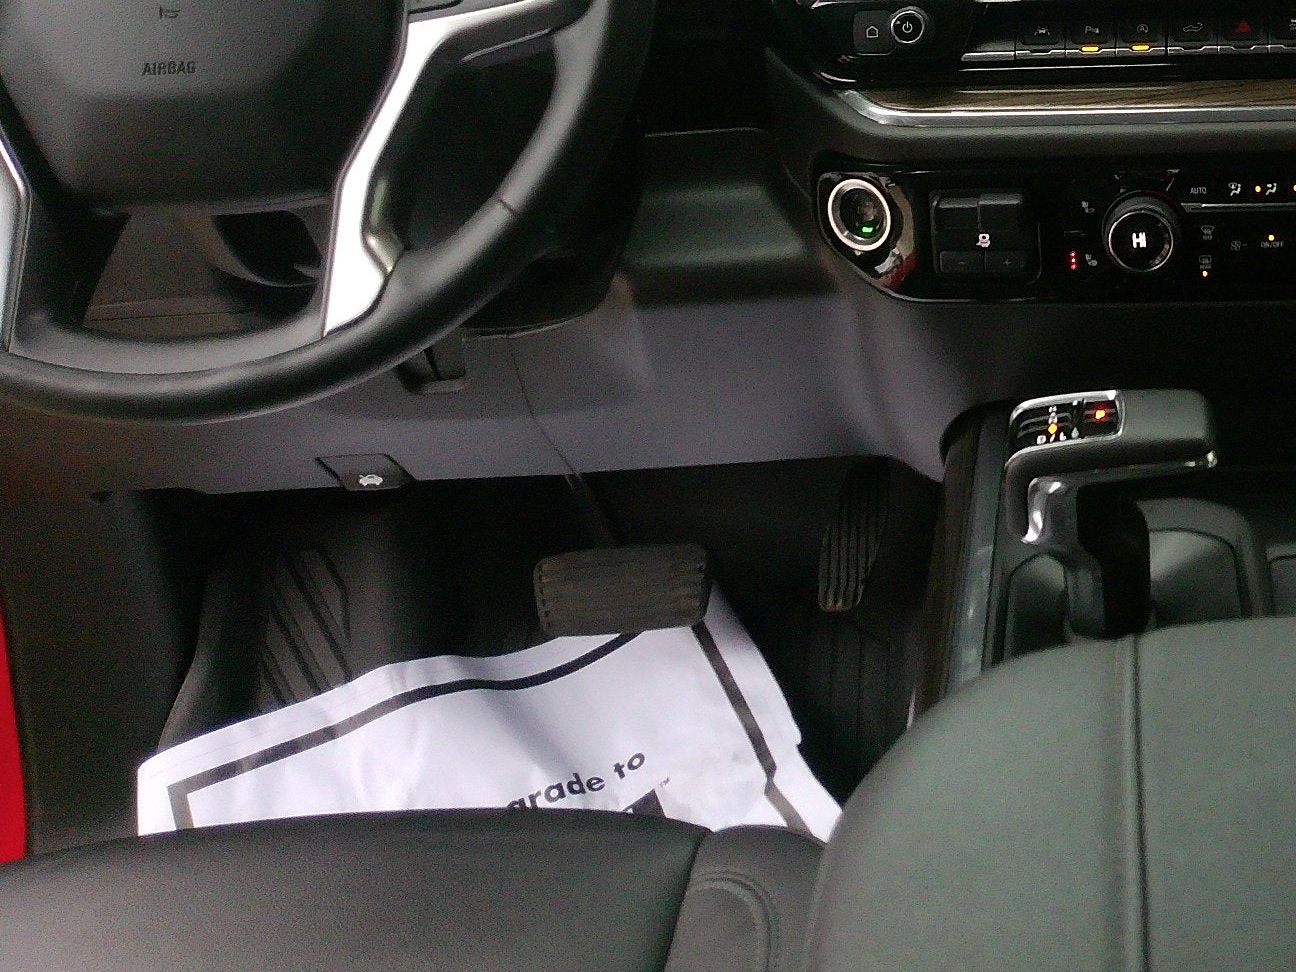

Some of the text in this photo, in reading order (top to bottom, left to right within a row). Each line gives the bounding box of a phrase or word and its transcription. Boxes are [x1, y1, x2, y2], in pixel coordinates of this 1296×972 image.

[141, 60, 197, 77] AIRBAG
[1189, 186, 1207, 195] AUTO
[613, 751, 646, 780] to
